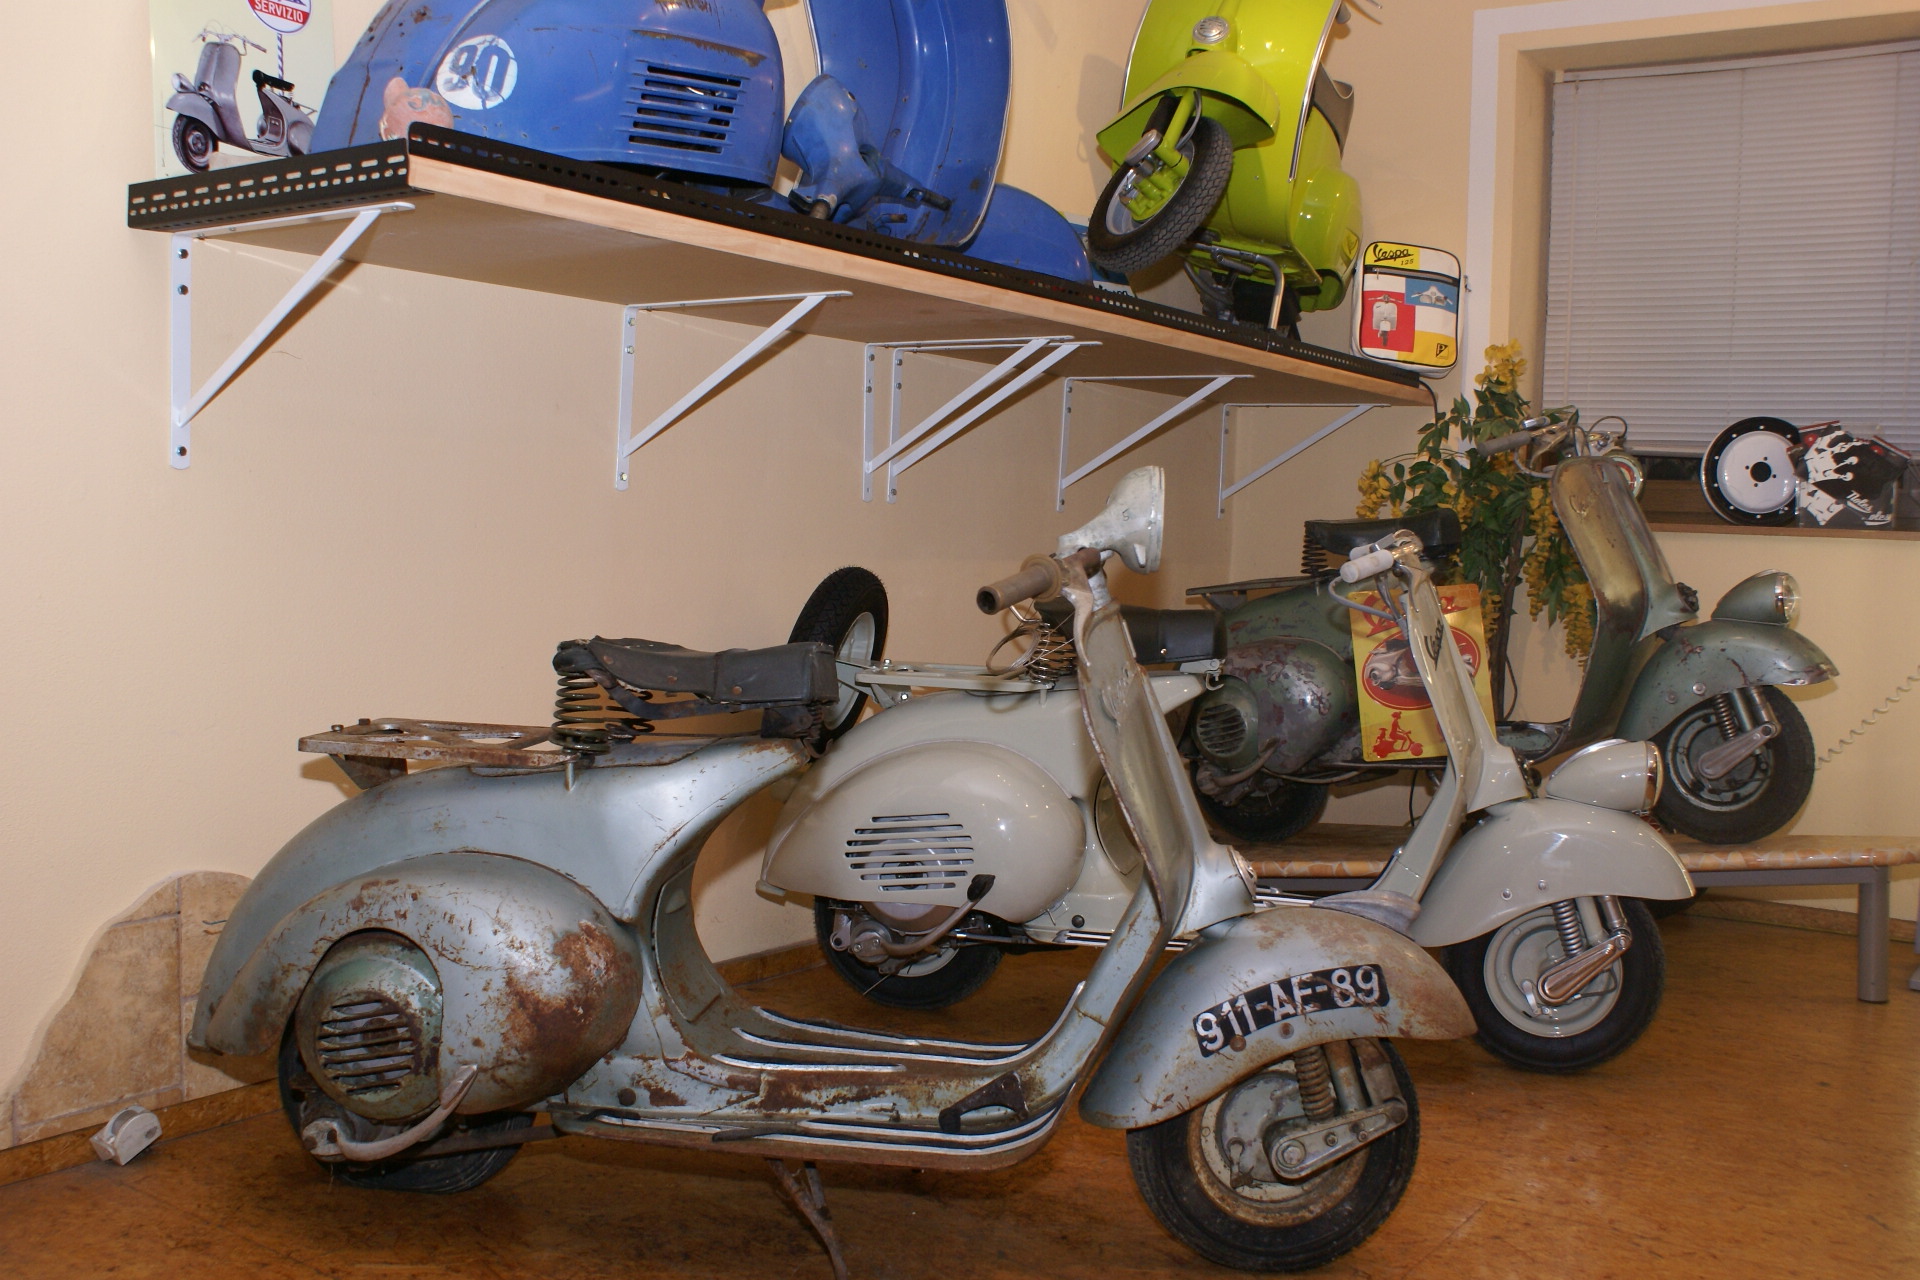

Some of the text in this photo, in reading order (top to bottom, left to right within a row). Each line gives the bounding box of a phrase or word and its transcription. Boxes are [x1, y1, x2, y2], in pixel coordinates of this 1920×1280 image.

[254, 0, 304, 23] SERVIZIO
[1373, 243, 1414, 263] Vespa
[1195, 965, 1381, 1051] 911-AE-89
